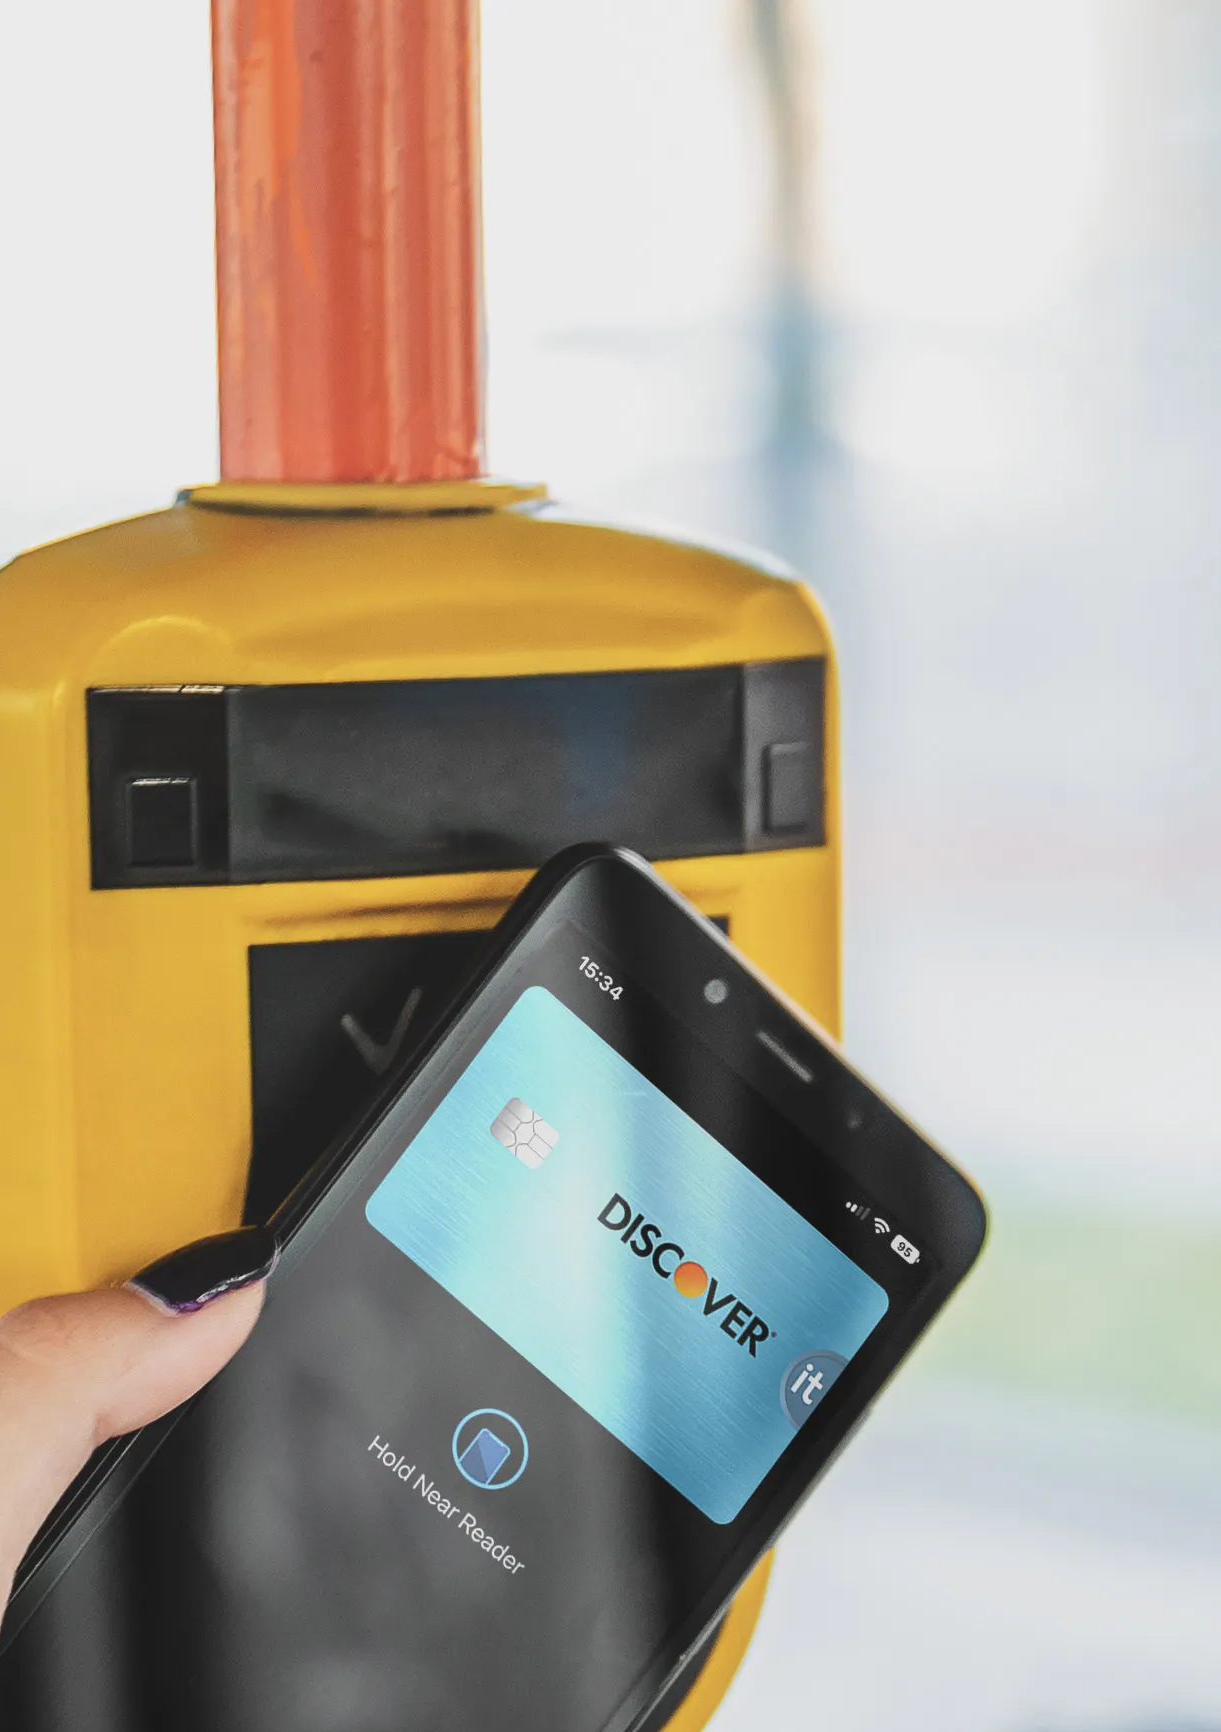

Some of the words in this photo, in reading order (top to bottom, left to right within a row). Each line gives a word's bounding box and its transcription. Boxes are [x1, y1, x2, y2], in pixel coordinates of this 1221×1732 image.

[579, 956, 624, 1001] 15:34
[897, 1241, 913, 1258] 95
[596, 1192, 769, 1358] DISCOVER
[790, 1363, 824, 1406] it
[367, 1435, 416, 1481] Hold
[412, 1473, 460, 1519] Near
[457, 1512, 525, 1574] Reader
